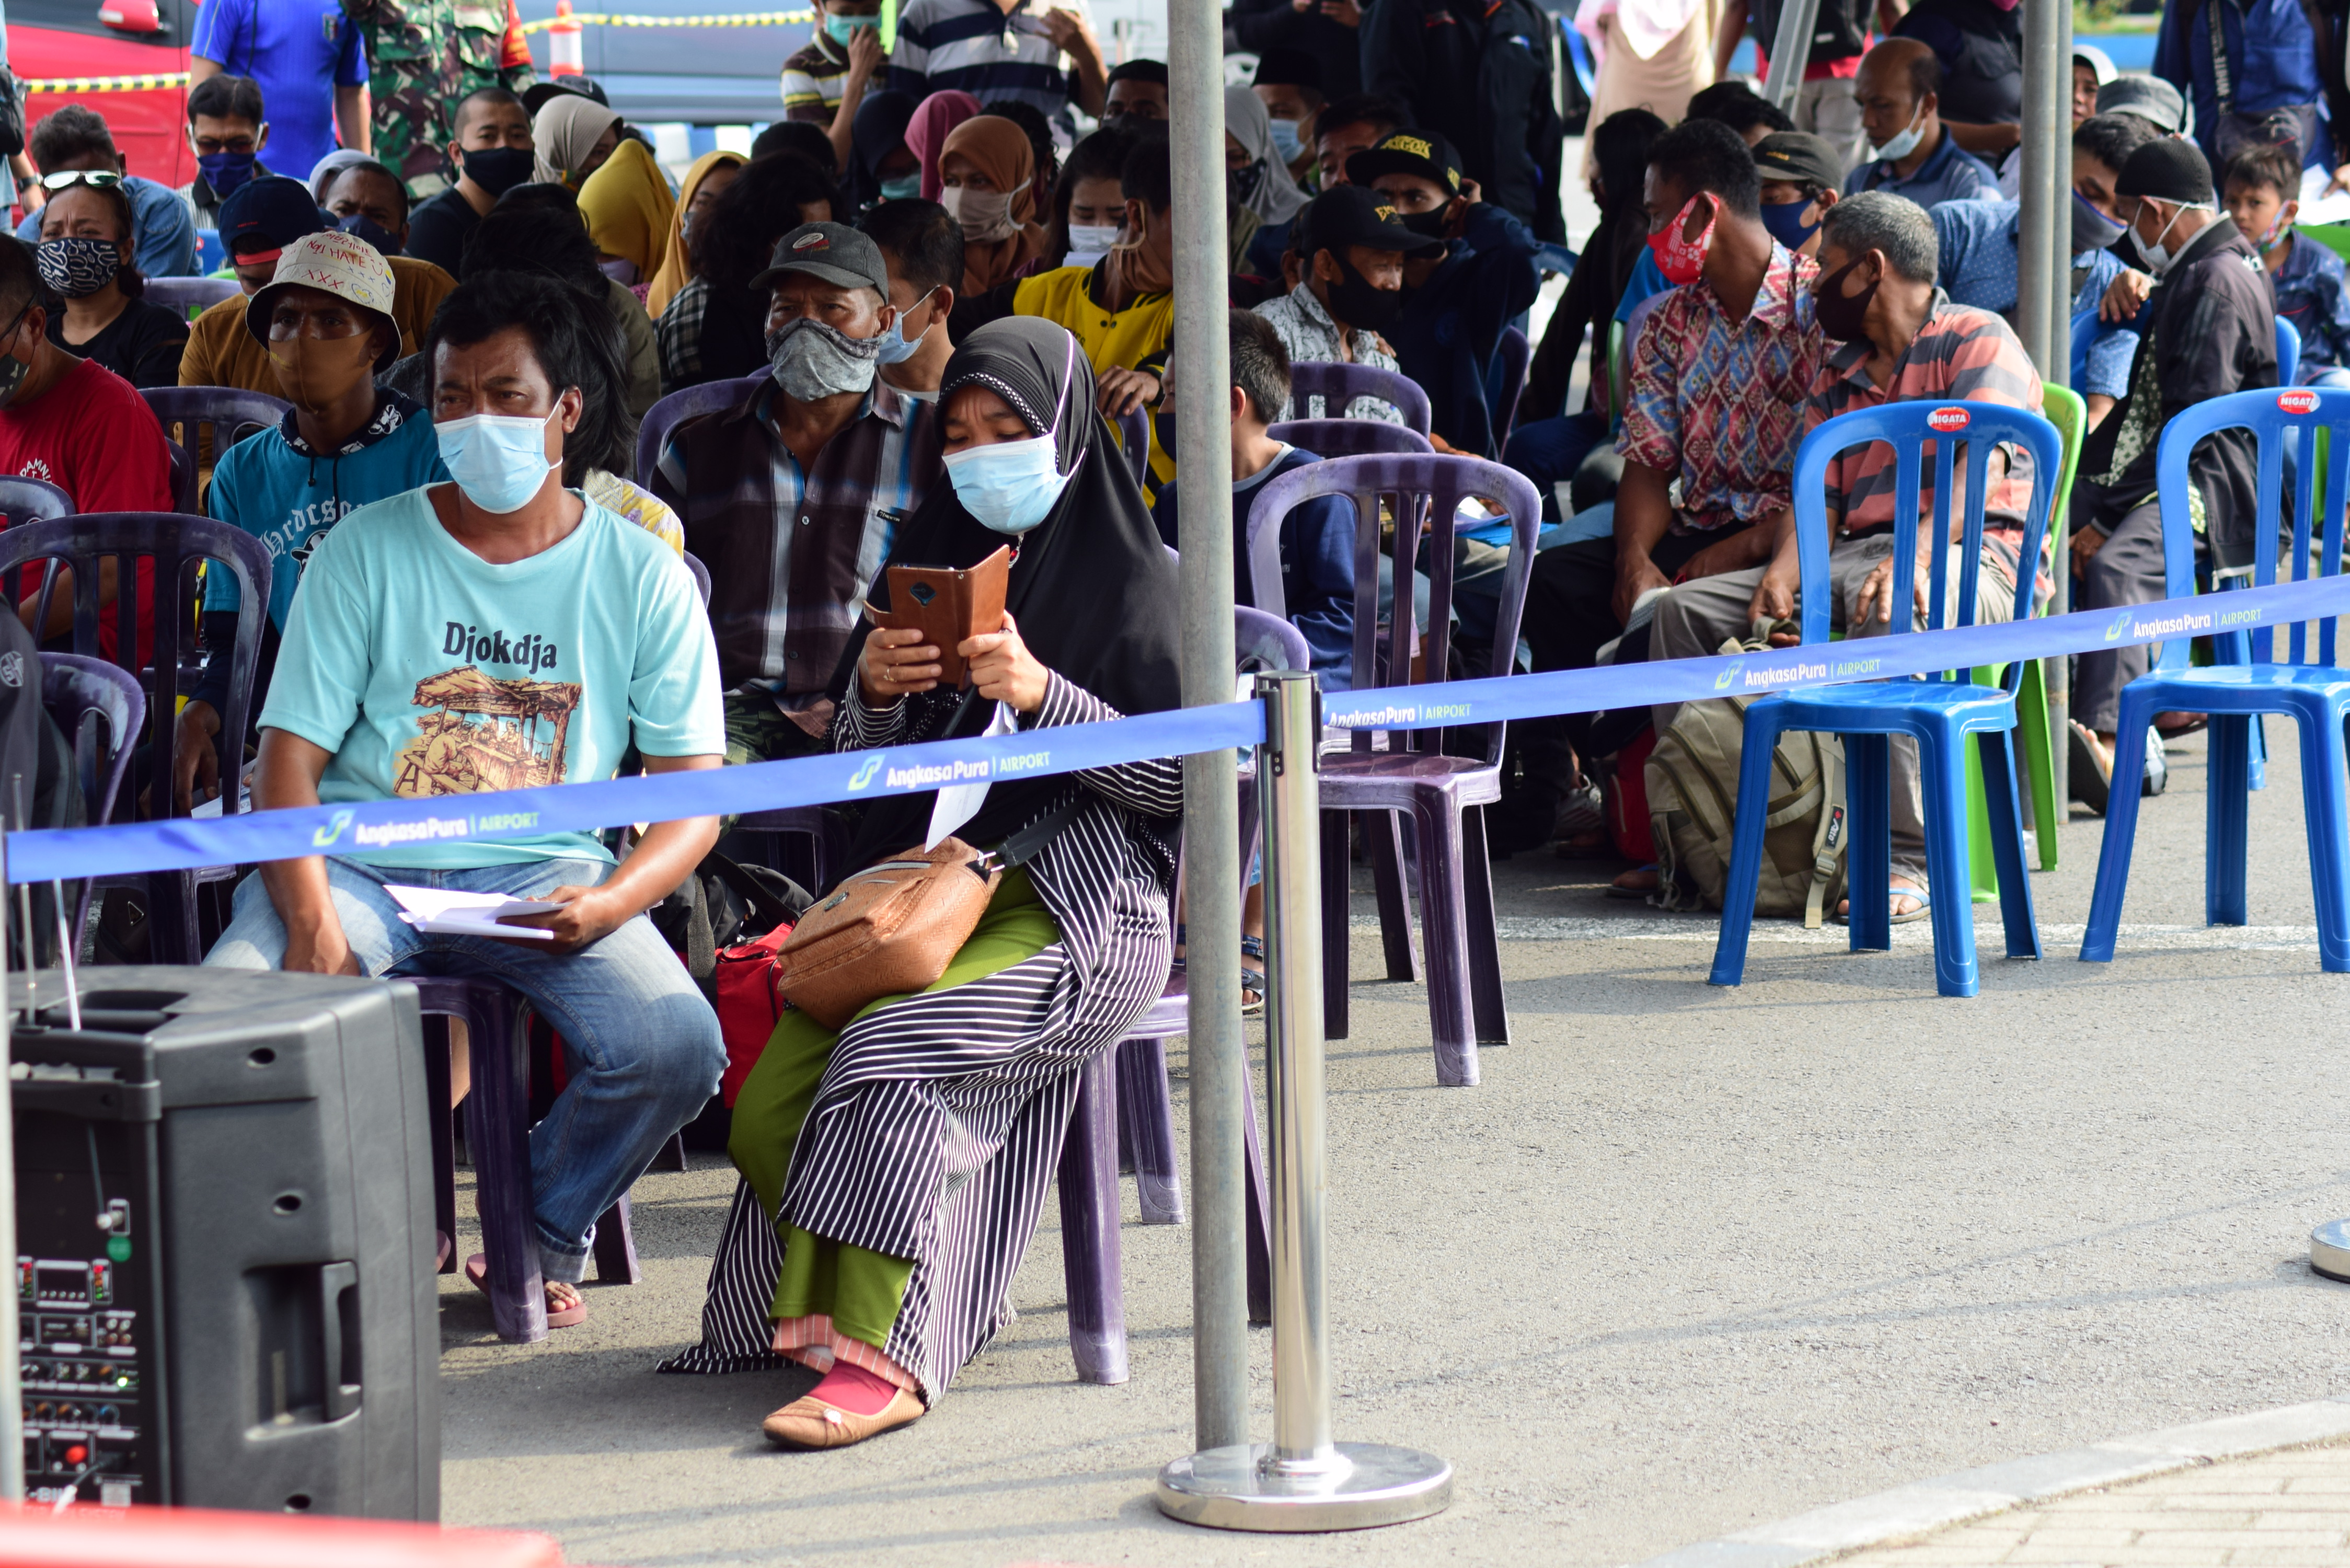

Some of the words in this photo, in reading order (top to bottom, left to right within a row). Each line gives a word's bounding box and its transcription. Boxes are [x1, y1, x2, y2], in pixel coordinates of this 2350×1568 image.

[2221, 608, 2262, 626] AIRPORT
[443, 621, 557, 674] Djokdja
[1837, 659, 1881, 676] AIRPORT
[1425, 704, 1472, 720] AIRPORT
[999, 752, 1050, 773] AIRPORT
[479, 812, 540, 832] AIRPORT
